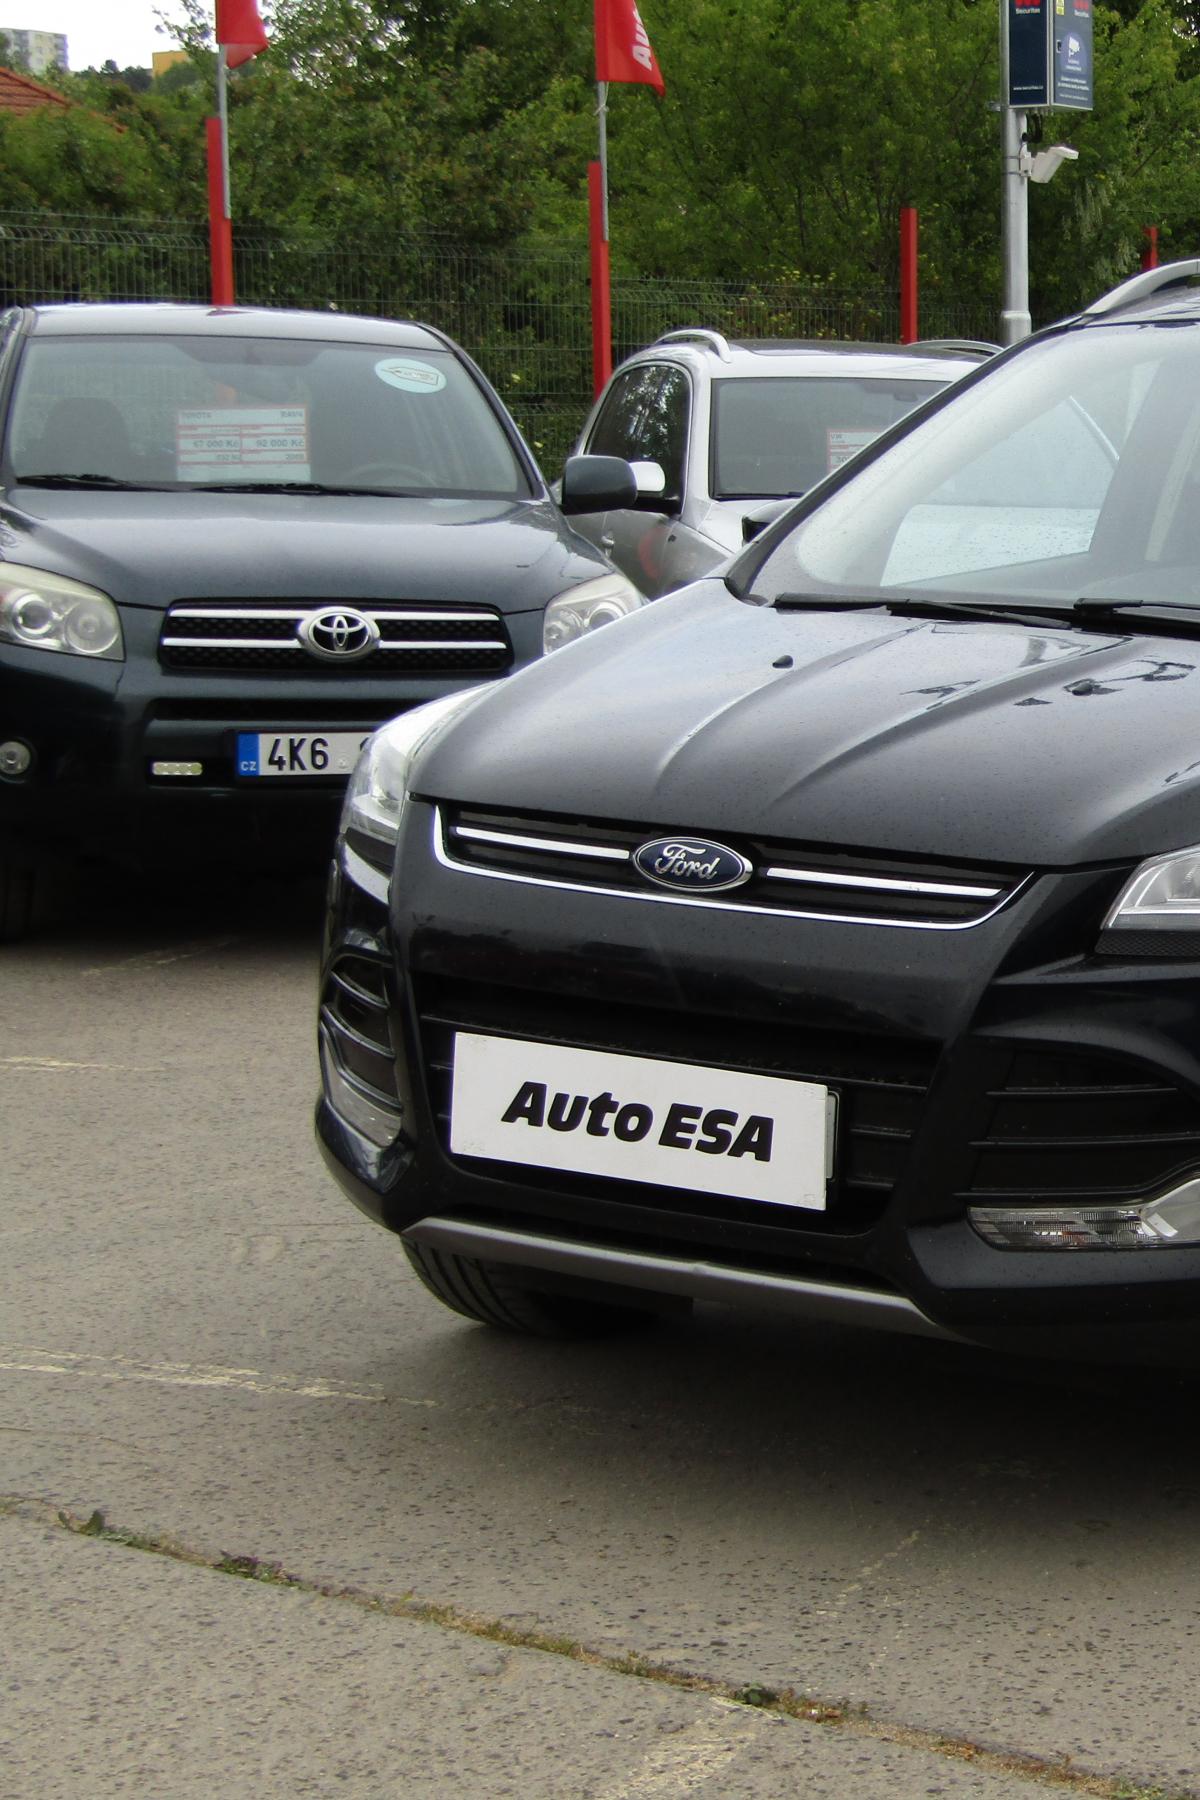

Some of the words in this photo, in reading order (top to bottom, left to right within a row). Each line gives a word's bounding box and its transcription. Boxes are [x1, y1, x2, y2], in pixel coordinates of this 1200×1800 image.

[240, 761, 257, 771] CZ
[268, 737, 330, 771] 4K6
[654, 843, 721, 881] Ford
[501, 1081, 654, 1143] Auto
[658, 1103, 775, 1163] ESA
